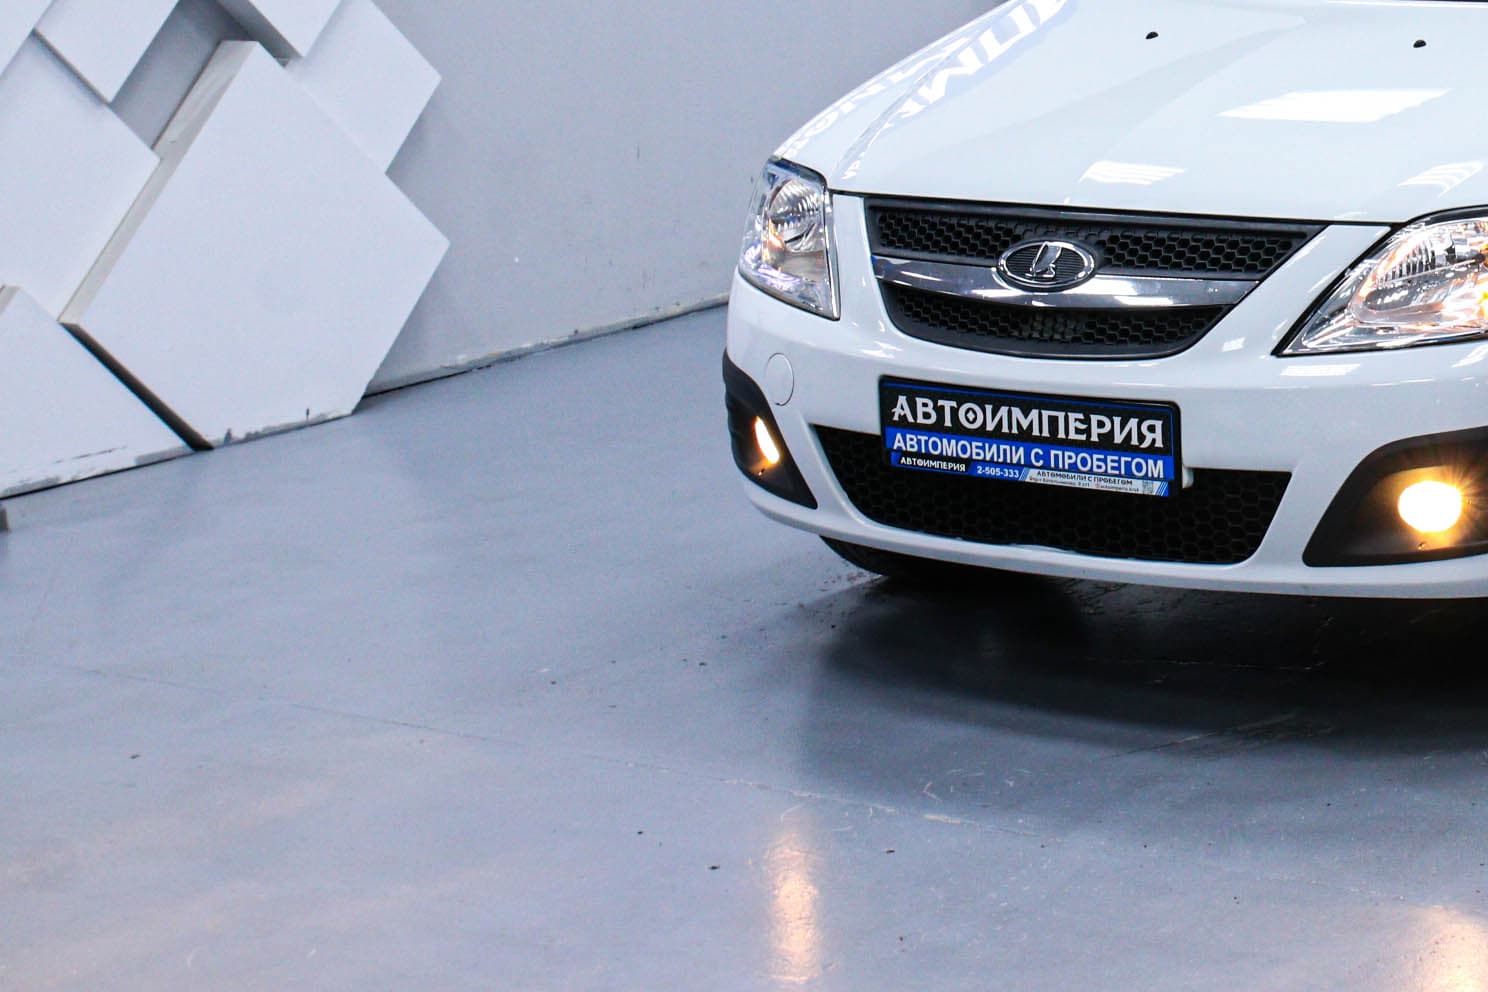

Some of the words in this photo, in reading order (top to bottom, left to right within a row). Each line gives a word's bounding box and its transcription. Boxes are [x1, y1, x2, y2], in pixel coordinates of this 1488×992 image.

[891, 395, 1165, 448] АВТОИМПЕРИЯ
[892, 433, 1026, 466] АВТОМОБИЛИ
[1031, 448, 1044, 467] С
[1050, 450, 1165, 479] ПРОБЕГОМ
[900, 457, 966, 472] АВТОИМПЕРИЯ
[976, 465, 1020, 478] 2-505-333
